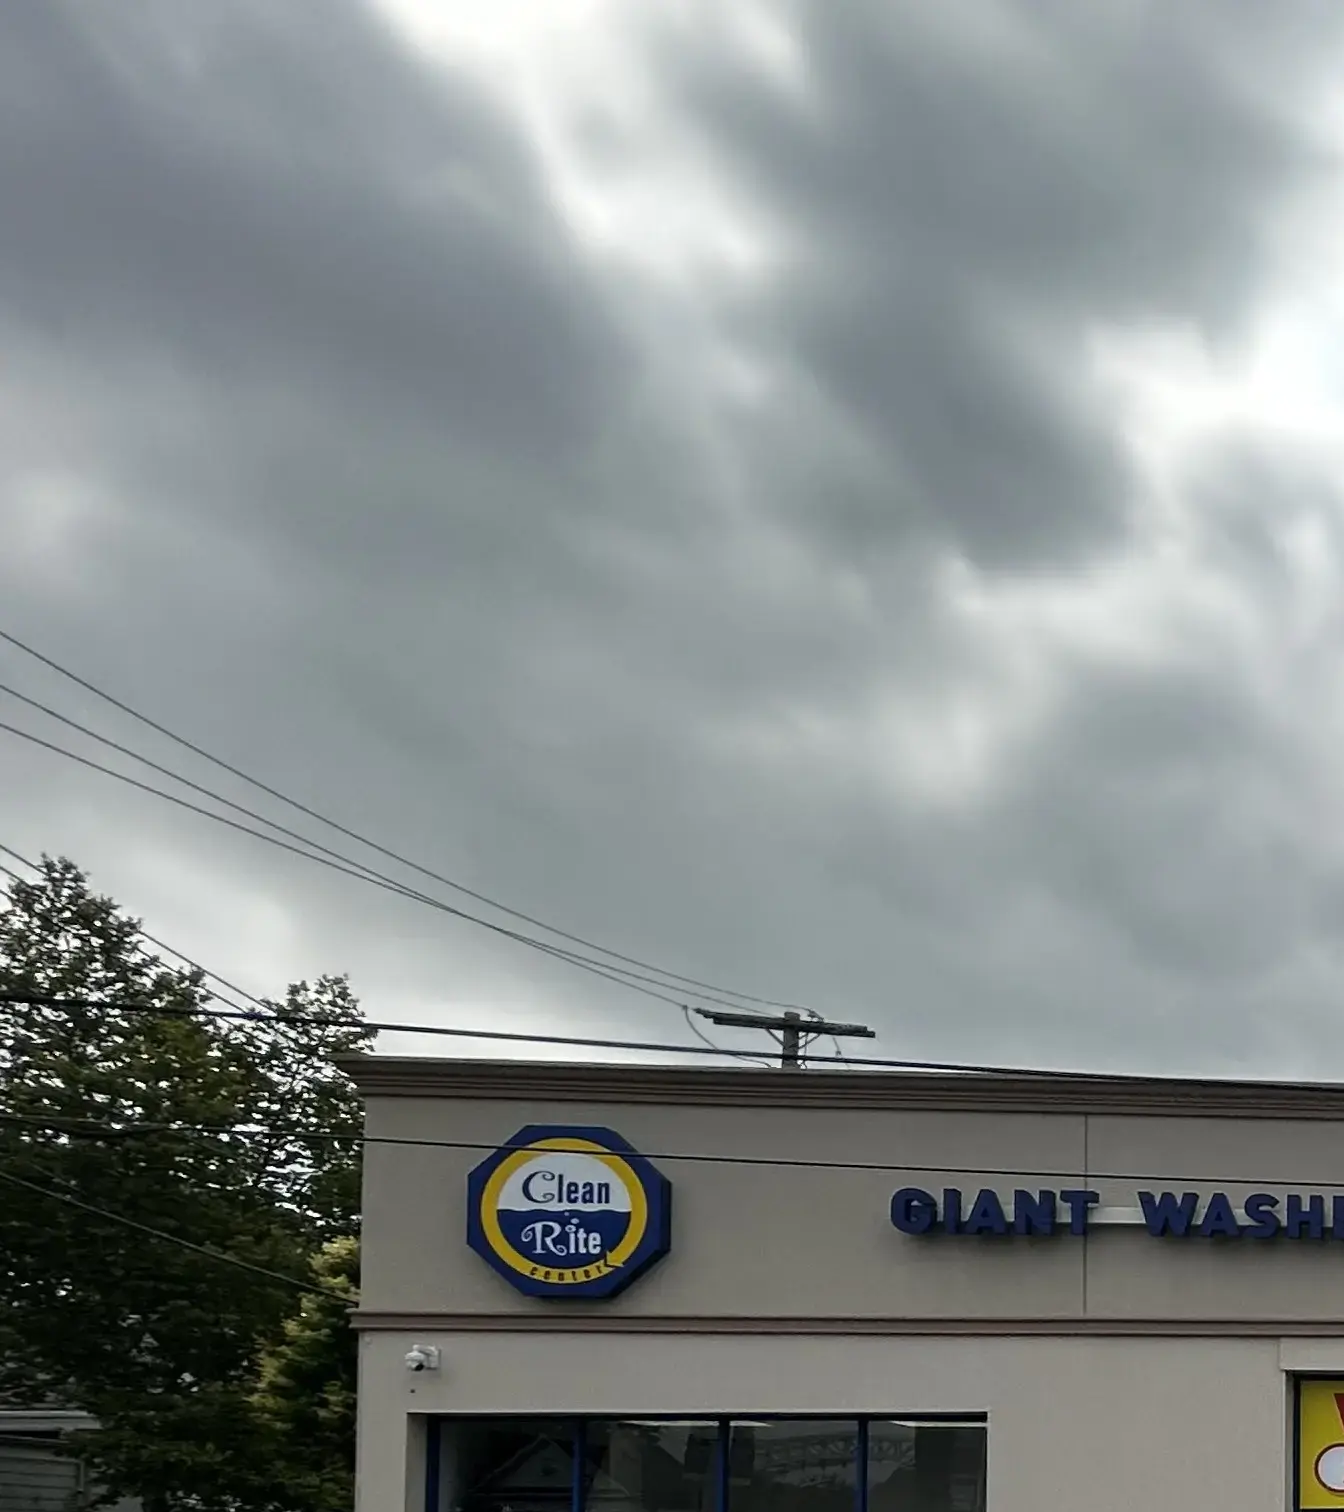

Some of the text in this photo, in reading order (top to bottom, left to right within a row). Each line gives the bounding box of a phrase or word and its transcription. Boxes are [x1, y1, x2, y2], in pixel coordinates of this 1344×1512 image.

[521, 1170, 610, 1204] Clean
[890, 1187, 1100, 1236] GIANT
[520, 1220, 602, 1256] Rite
